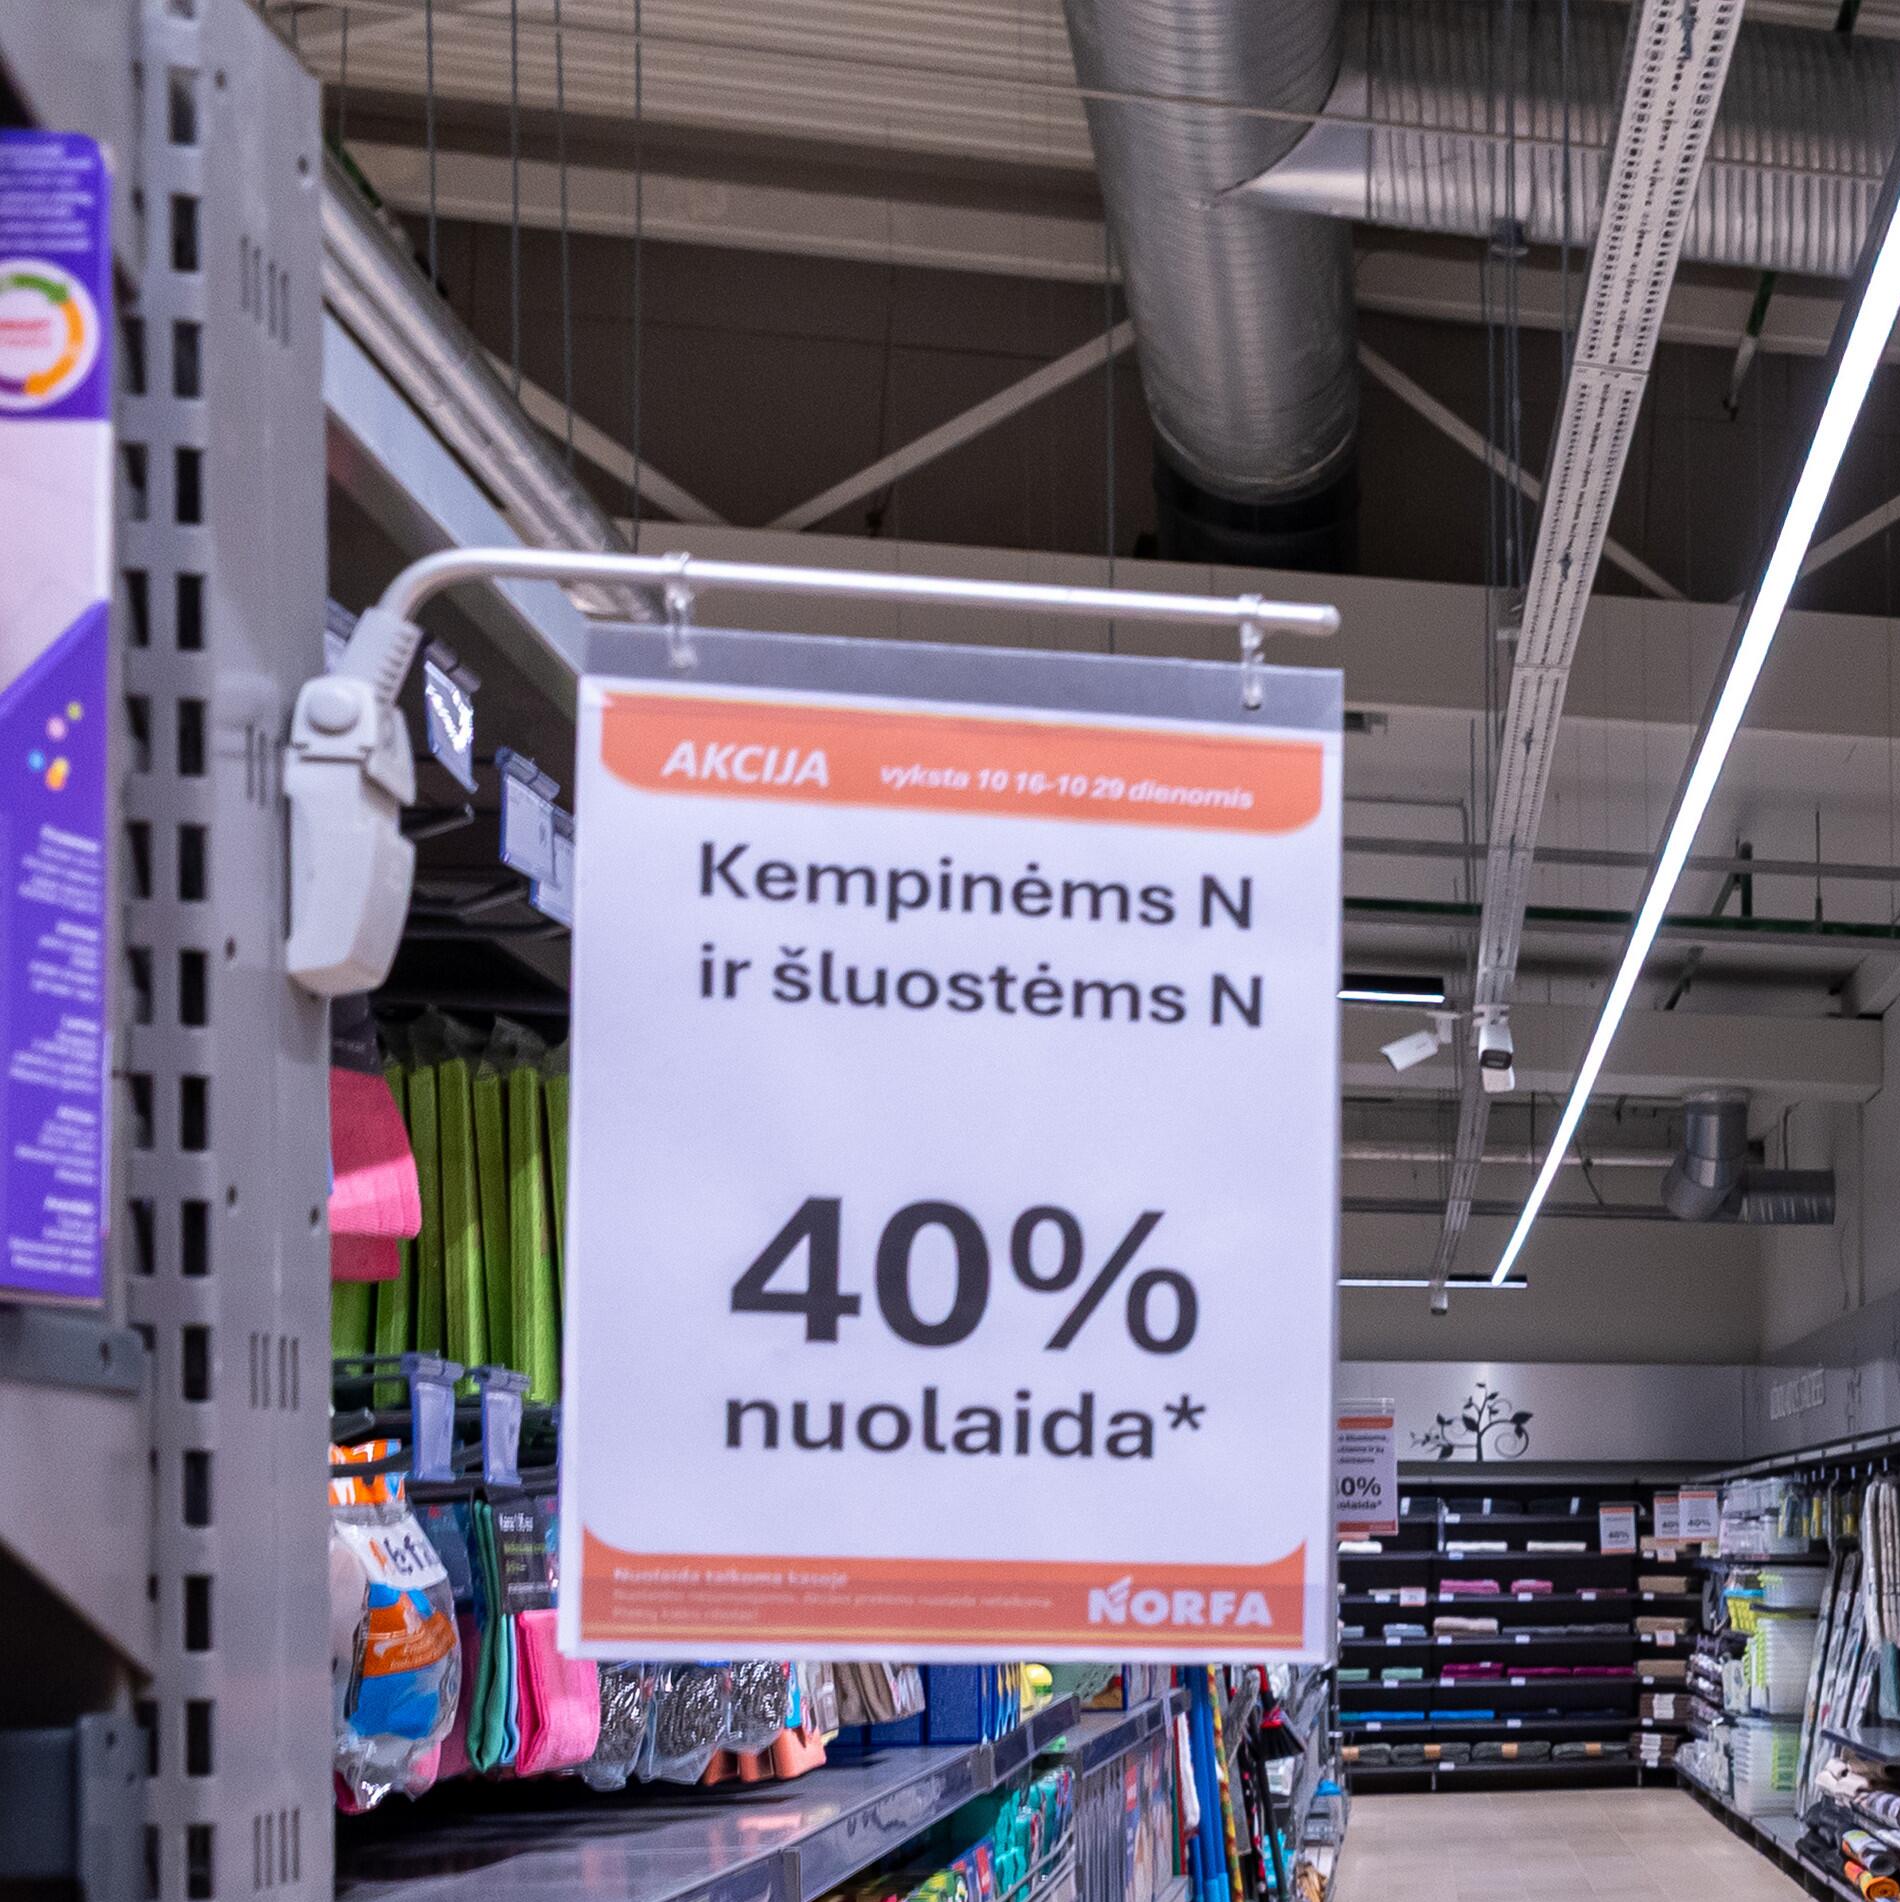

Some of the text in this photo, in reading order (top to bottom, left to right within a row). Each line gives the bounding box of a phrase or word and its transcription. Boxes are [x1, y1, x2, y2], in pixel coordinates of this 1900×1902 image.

[662, 739, 829, 788] AKCIJA
[879, 764, 968, 791] vyksta
[978, 769, 1007, 793] 10
[1091, 778, 1125, 801] 29
[1128, 779, 1254, 809] dienomis
[699, 841, 1252, 930] Kempinėms N
[699, 943, 1263, 1029] ir šluostėms N
[730, 1196, 1201, 1355] 40%
[1088, 1576, 1273, 1628] NORFA
